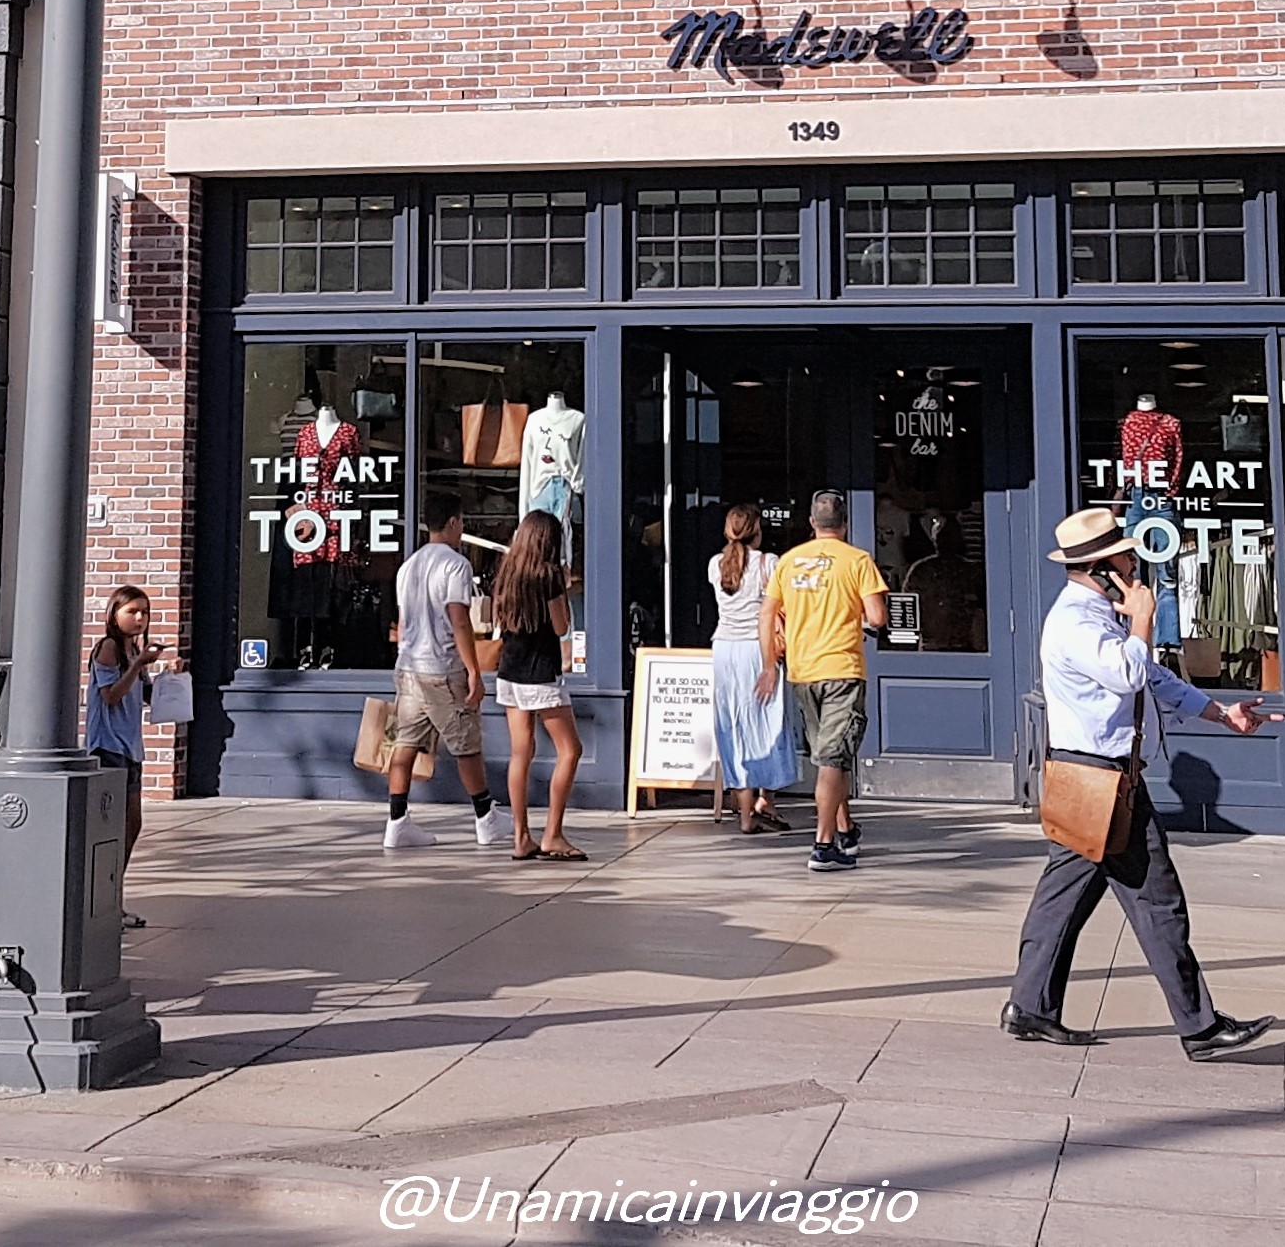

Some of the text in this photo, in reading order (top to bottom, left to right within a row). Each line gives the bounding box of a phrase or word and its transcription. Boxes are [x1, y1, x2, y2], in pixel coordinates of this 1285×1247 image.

[660, 6, 974, 85] Madewell
[787, 120, 841, 142] 1349
[912, 386, 939, 410] the
[895, 411, 954, 437] DENIM
[910, 437, 938, 455] bar
[250, 456, 399, 483] THE ART
[1088, 459, 1262, 489] THE ART
[294, 490, 354, 504] OF THE
[1141, 496, 1211, 511] OF THE
[761, 509, 790, 519] OPEN
[249, 509, 399, 552] TOTE
[655, 677, 661, 685] A
[663, 677, 676, 685] JOB
[691, 678, 710, 686] COOL
[664, 696, 681, 704] CALL
[691, 697, 711, 705] WORK
